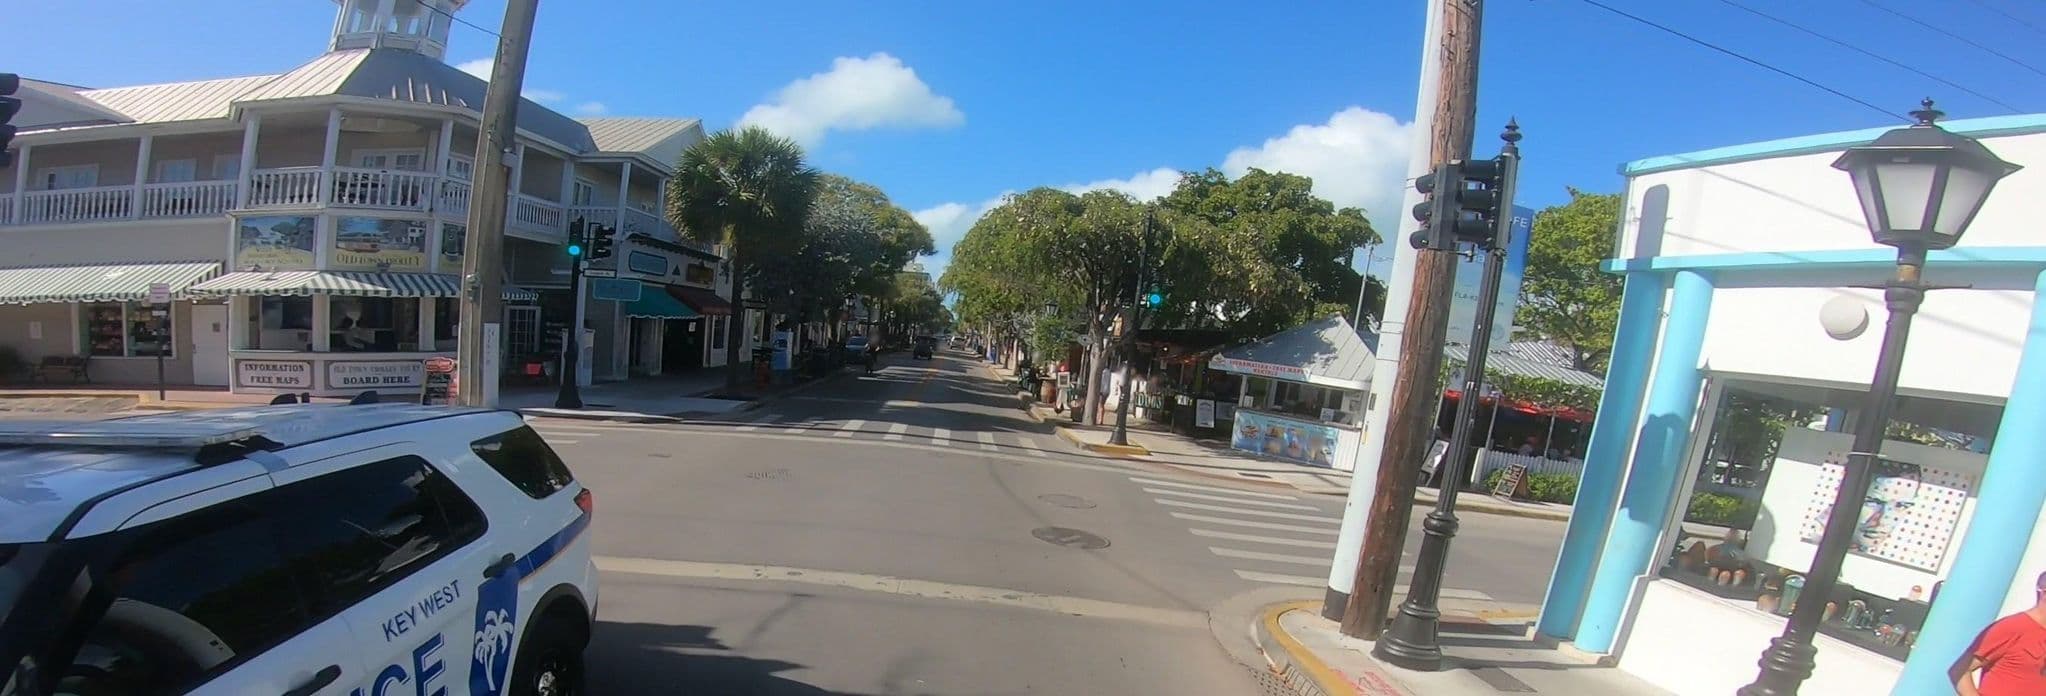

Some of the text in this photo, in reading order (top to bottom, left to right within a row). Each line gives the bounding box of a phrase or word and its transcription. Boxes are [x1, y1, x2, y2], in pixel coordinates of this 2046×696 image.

[244, 363, 304, 372] INFORMATION
[250, 375, 300, 385] FREE MAPS
[343, 375, 411, 385] BOARD HERE
[382, 580, 460, 642] KEY WEST
